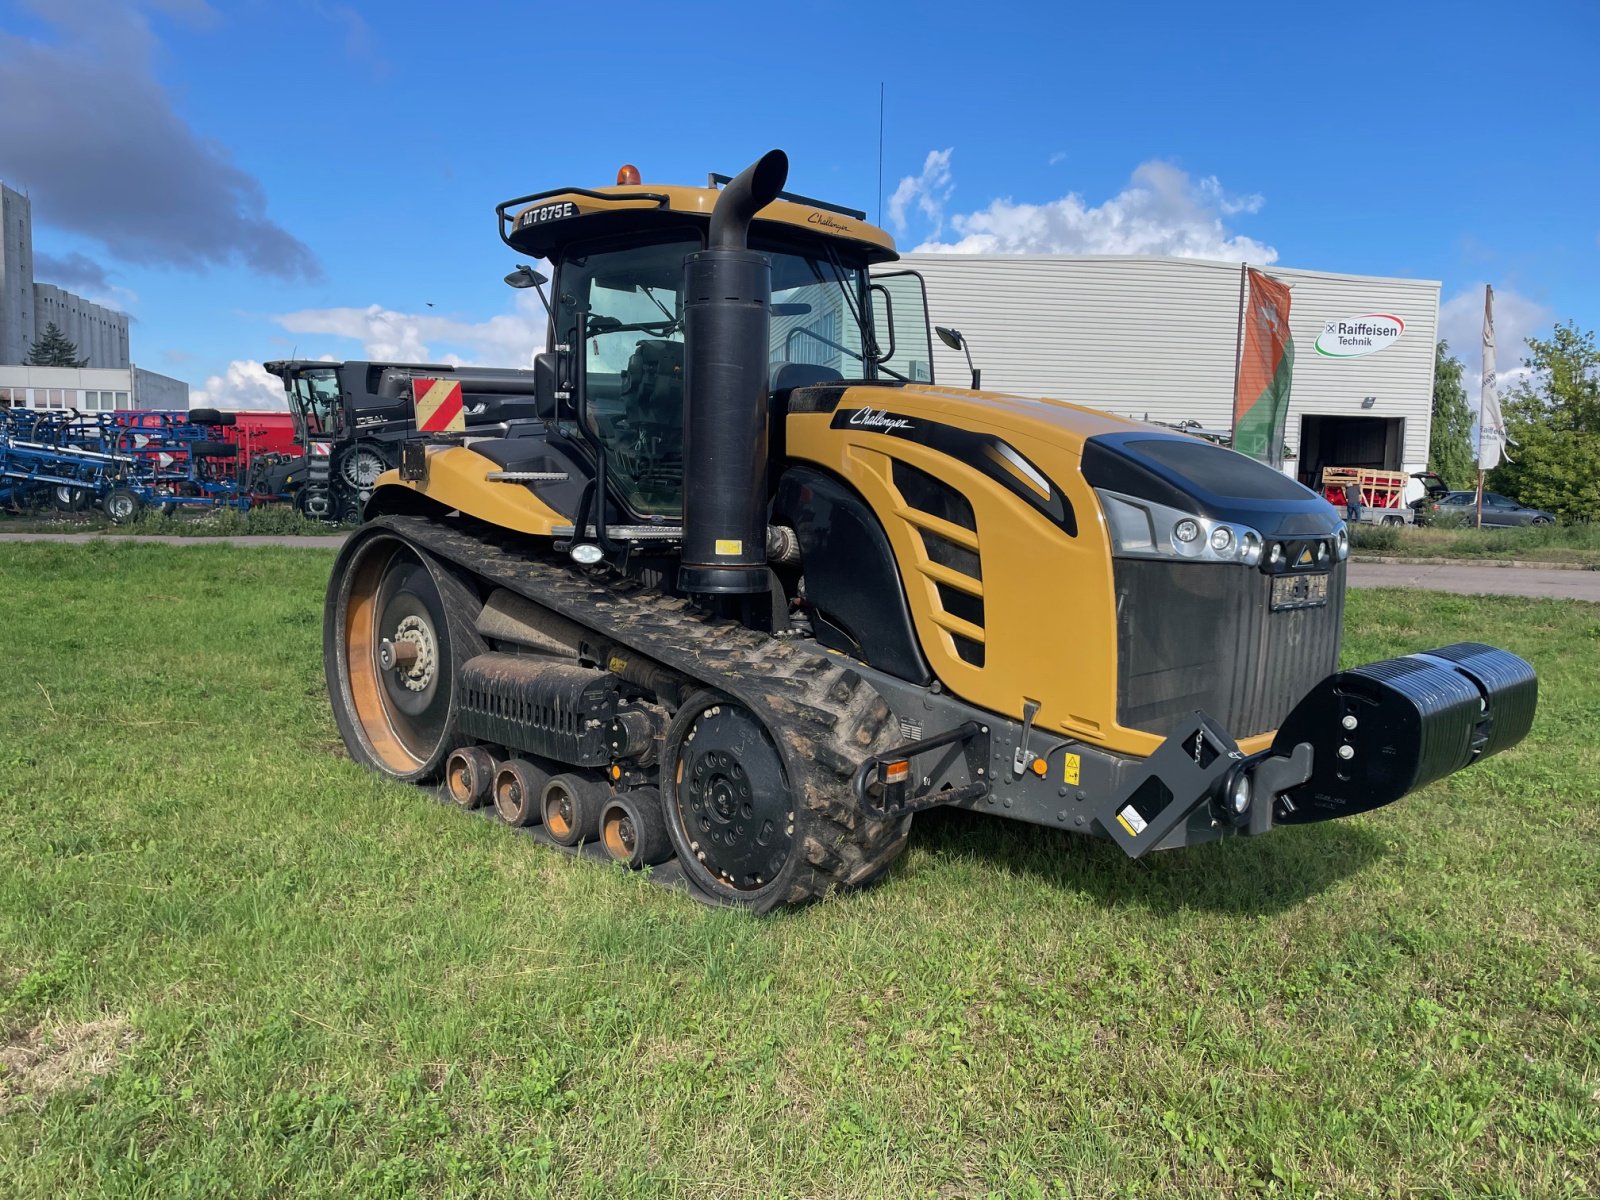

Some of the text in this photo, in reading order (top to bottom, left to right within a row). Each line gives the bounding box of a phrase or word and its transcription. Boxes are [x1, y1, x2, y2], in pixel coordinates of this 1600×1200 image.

[807, 212, 853, 233] Challenger
[1338, 322, 1398, 337] Raiffeisen
[1338, 336, 1372, 347] Technik
[356, 415, 389, 425] IDEAL
[849, 405, 916, 434] Challenger
